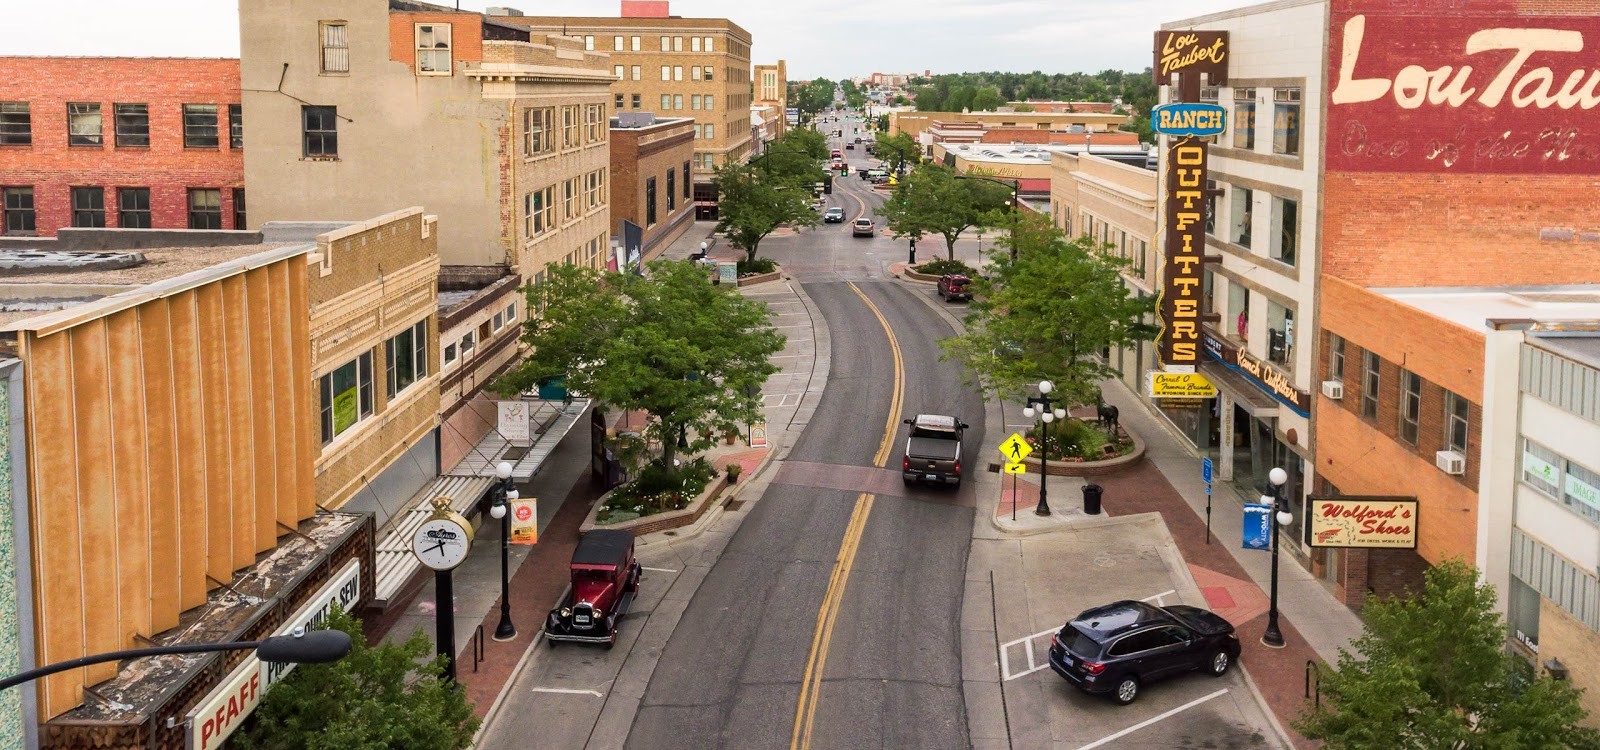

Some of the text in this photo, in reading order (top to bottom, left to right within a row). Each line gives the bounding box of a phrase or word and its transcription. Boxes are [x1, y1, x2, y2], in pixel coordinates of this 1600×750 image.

[1162, 32, 1199, 56] Lou
[1160, 37, 1225, 76] Taubert
[1332, 14, 1476, 109] Lou
[1160, 110, 1222, 129] RANCH
[1172, 146, 1203, 361] OUTFITTERS
[1155, 374, 1191, 384] Corral O
[1161, 382, 1211, 391] Famous Brands
[1237, 346, 1299, 405] Ranch Outfitters
[1573, 481, 1597, 504] IMAGE
[1321, 503, 1412, 524] Wolford's
[1359, 519, 1411, 535] Shoes
[339, 574, 358, 608] SEW
[201, 672, 258, 750] PFAFF
